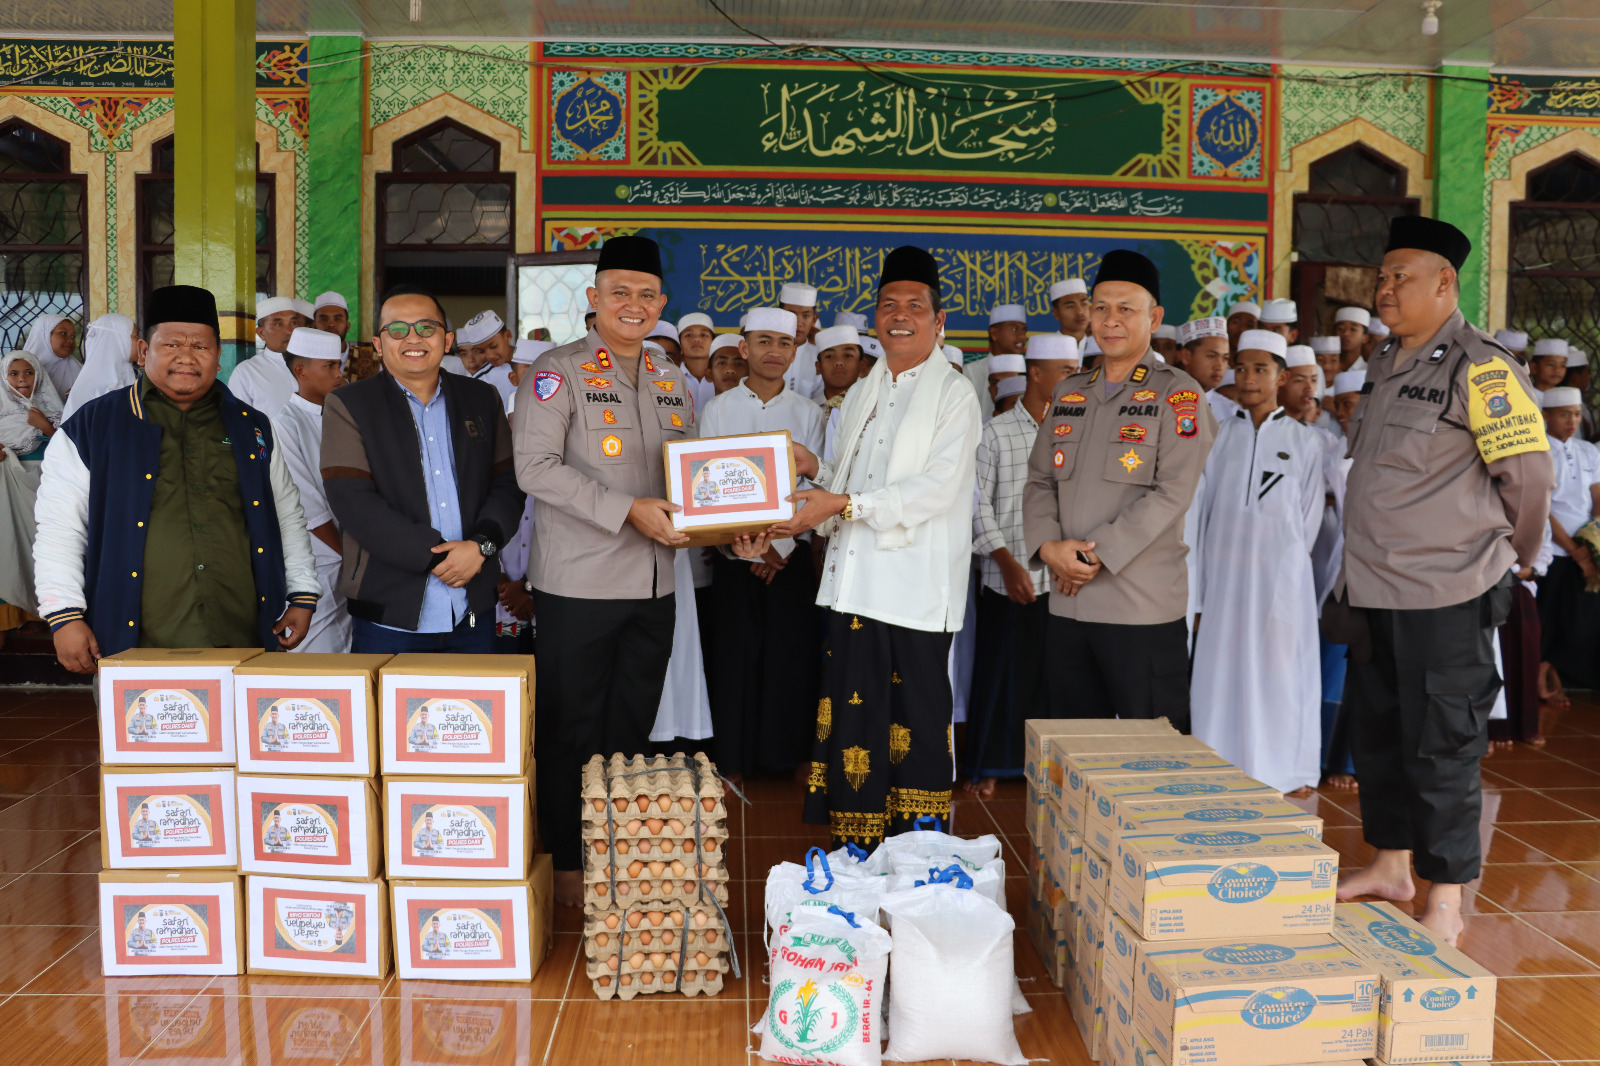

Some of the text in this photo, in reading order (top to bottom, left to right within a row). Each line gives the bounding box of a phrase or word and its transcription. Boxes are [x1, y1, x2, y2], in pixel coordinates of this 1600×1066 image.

[586, 392, 622, 404] FAISAL
[1398, 384, 1446, 404] POLRI
[657, 396, 684, 407] POLRI
[1118, 404, 1159, 417] POLRI
[1496, 428, 1531, 442] KALANG
[1496, 436, 1539, 451] SIDIKALANG
[163, 702, 190, 712] safari
[294, 712, 321, 722] safari
[162, 722, 181, 730] POLRES
[165, 807, 192, 817] safari
[1316, 862, 1331, 874] 10
[1214, 875, 1271, 889] Country
[1218, 888, 1264, 900] Choice
[1301, 904, 1332, 914] 24 Pak
[781, 946, 826, 972] GOHAN
[1358, 982, 1373, 996] 10
[862, 998, 871, 1008] IR
[1424, 994, 1456, 1002] Country
[1250, 1000, 1310, 1014] Country
[778, 1010, 788, 1025] G
[830, 1012, 838, 1028] J
[1252, 1012, 1300, 1026] Choice
[862, 1012, 870, 1042] BERAS
[1341, 1028, 1374, 1039] 24 Pak
